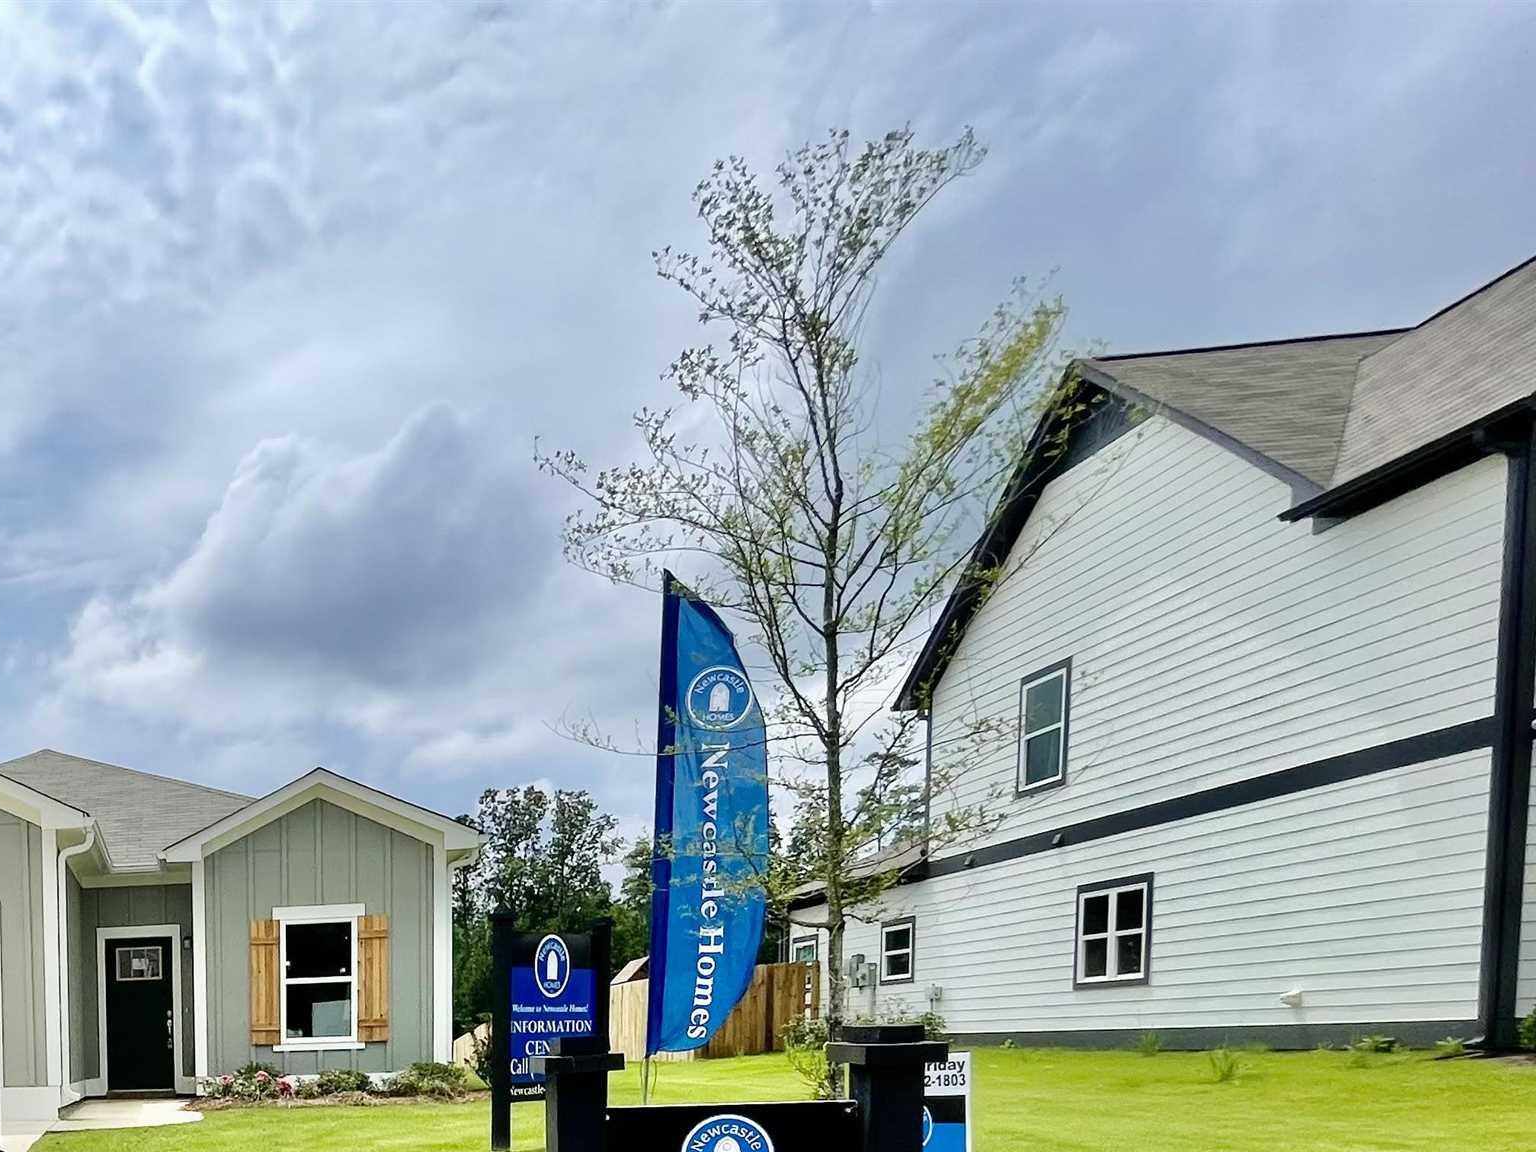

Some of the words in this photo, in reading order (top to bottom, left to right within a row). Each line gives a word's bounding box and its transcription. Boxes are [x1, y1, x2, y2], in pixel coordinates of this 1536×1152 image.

[700, 742, 730, 918] Newcastle
[687, 926, 724, 1039] Homes
[525, 1040, 551, 1055] CEN
[510, 1057, 529, 1075] Call
[927, 1061, 965, 1073] riday
[923, 1074, 966, 1087] 2-1803
[690, 1124, 762, 1152] Newcastle
